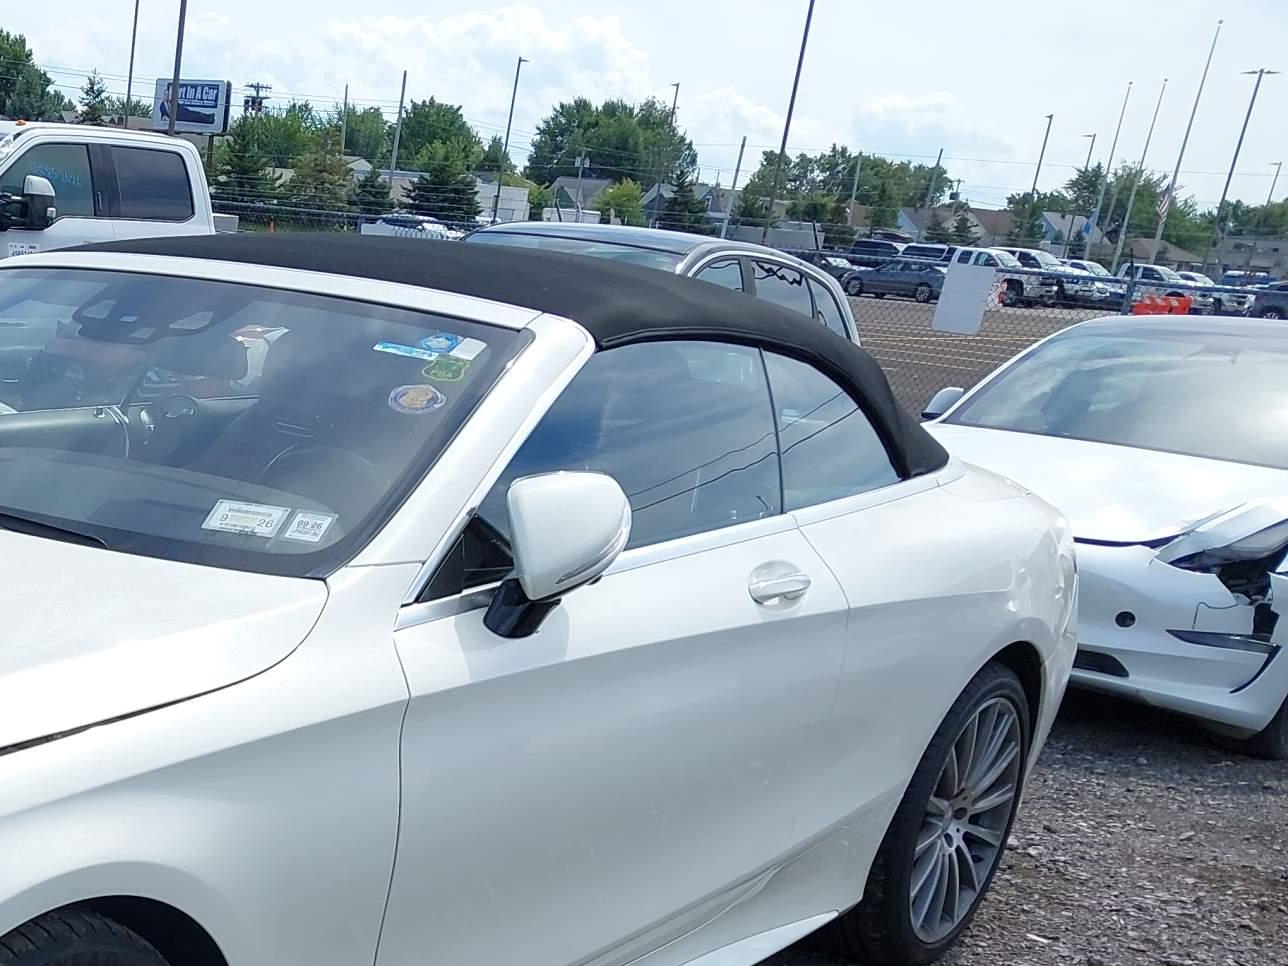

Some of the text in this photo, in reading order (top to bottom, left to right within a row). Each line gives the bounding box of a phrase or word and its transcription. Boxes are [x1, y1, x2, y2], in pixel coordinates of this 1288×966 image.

[187, 86, 195, 99] In
[196, 86, 202, 99] A
[202, 86, 218, 100] Car
[256, 518, 275, 528] 26
[310, 522, 324, 530] 26
